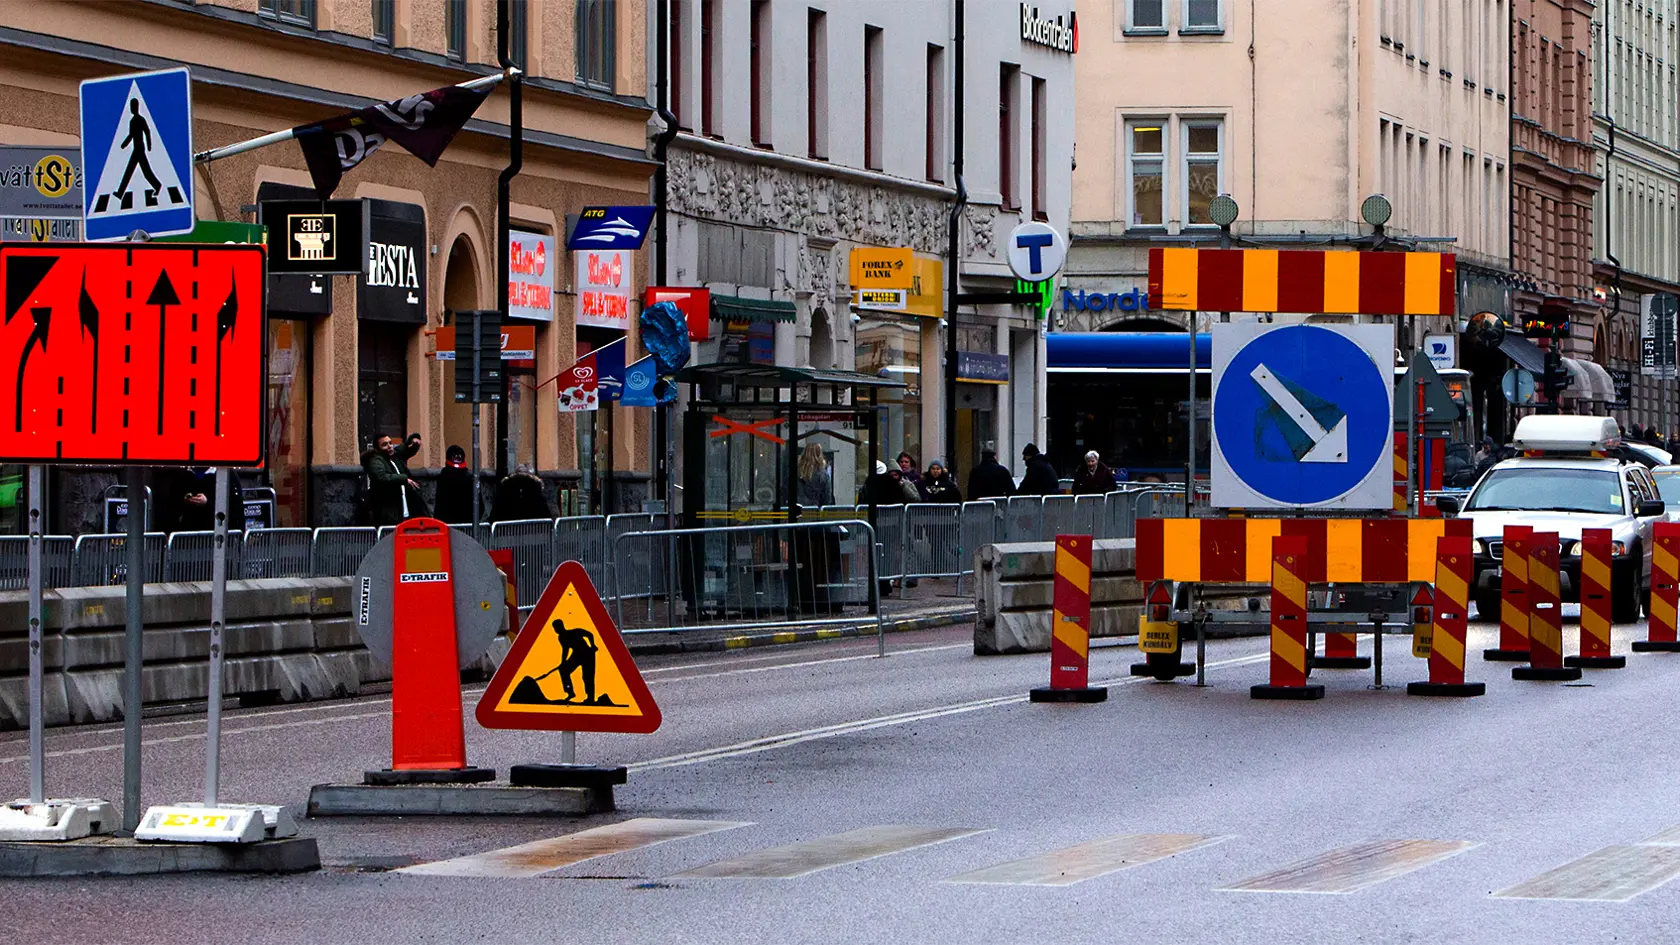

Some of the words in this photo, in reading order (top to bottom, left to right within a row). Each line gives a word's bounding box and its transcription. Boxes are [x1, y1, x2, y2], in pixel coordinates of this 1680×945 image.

[1020, 3, 1073, 52] Blodcentralen
[1016, 234, 1053, 274] T
[862, 261, 892, 269] FOREX
[865, 270, 891, 278] BANK
[1645, 340, 1654, 367] Hi-Fi
[633, 374, 643, 383] SL
